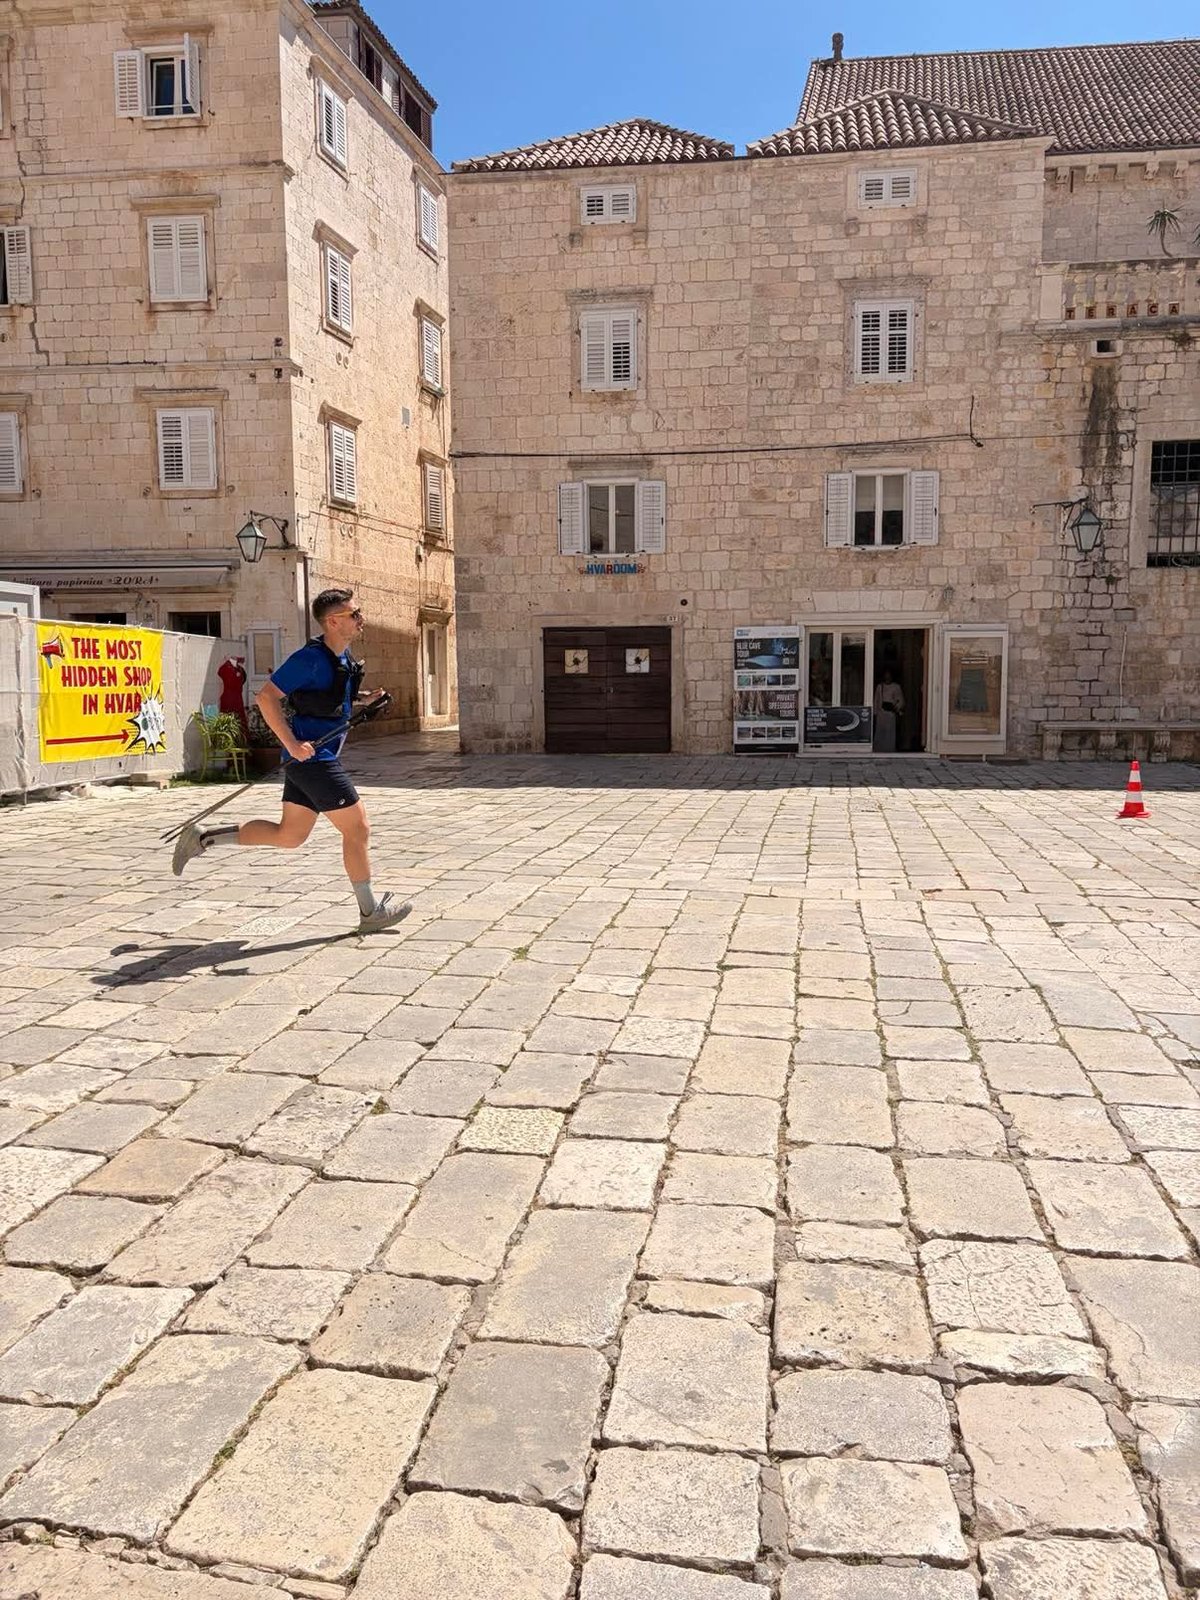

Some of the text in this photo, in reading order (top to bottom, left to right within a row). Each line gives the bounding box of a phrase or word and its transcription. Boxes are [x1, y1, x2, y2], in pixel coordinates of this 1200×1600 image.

[1065, 303, 1179, 319] TERACA
[587, 563, 637, 575] HVAROOM
[71, 637, 143, 661] THE MOST
[749, 641, 761, 650] CAVE
[61, 666, 152, 688] HIDDEN SHOP
[83, 692, 143, 715] IN HVAR
